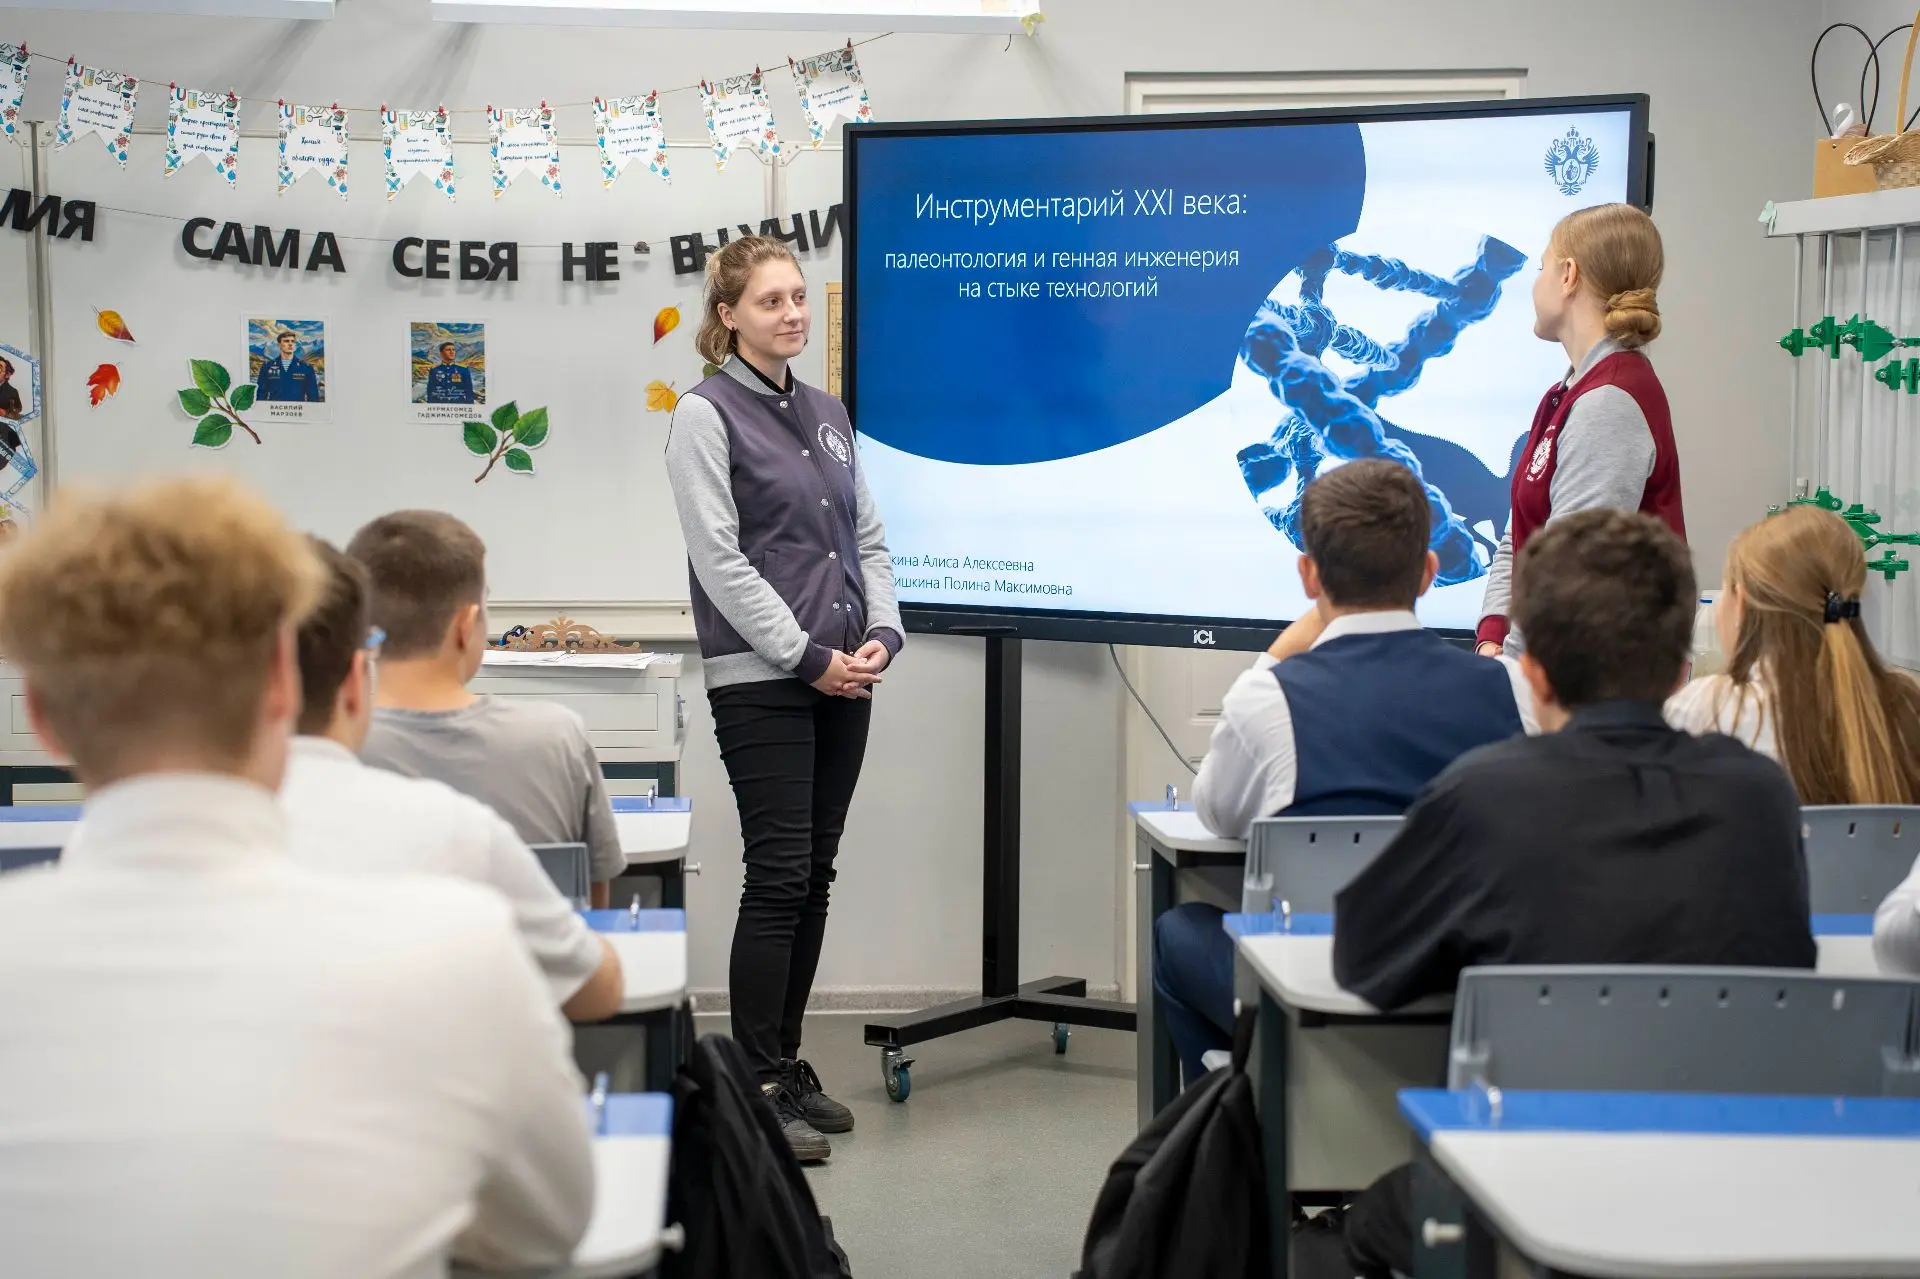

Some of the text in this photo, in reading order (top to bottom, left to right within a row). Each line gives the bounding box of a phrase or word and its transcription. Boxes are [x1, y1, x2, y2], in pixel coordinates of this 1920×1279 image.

[915, 188, 1248, 227] Инструментарий XXI века:
[181, 217, 346, 273] САМА
[392, 236, 519, 281] СЕБЯ
[562, 242, 620, 281] НЕ
[884, 249, 1240, 273] палеонтология и генная инженерия
[958, 275, 1159, 298] на стыке технологий
[922, 554, 959, 569] Алиса
[962, 556, 1034, 572] Алексеевна
[944, 576, 991, 592] Полина
[994, 579, 1073, 596] Максимовна
